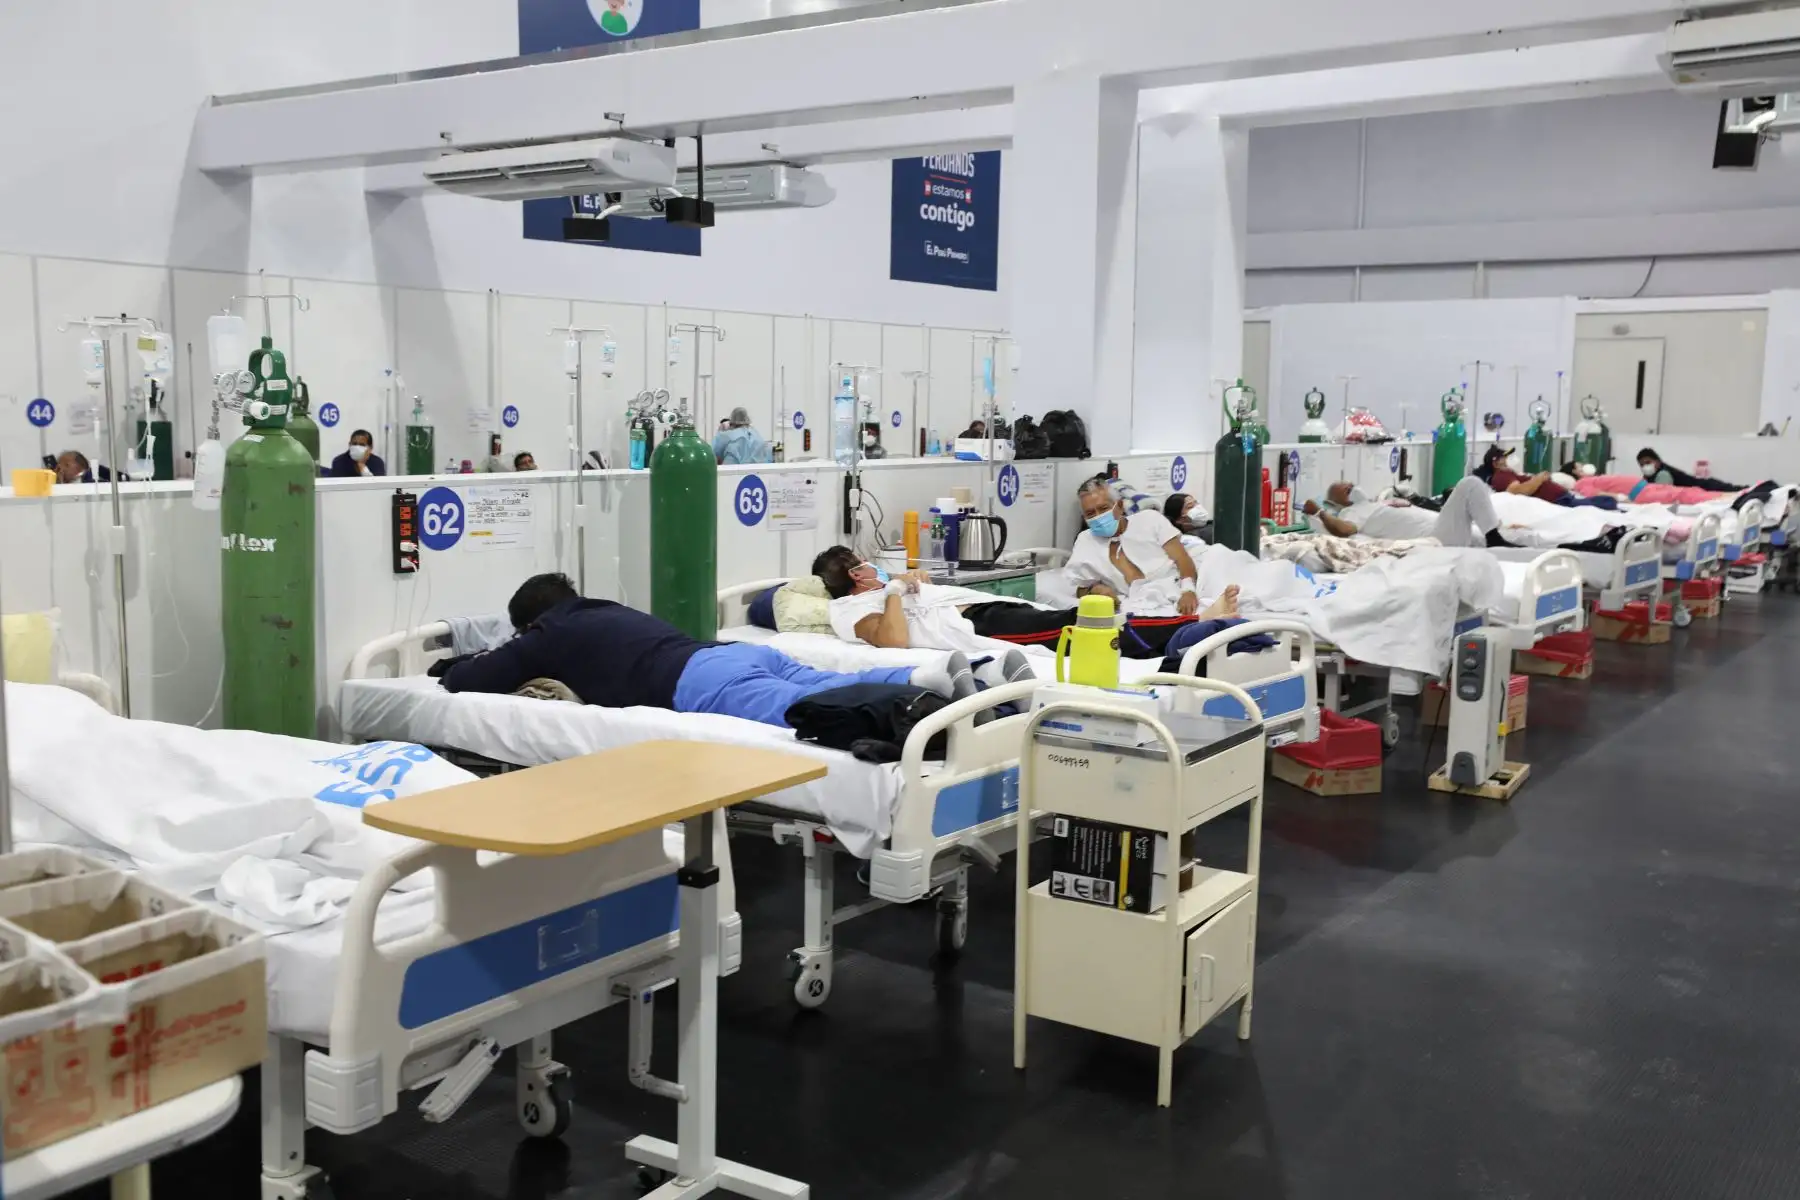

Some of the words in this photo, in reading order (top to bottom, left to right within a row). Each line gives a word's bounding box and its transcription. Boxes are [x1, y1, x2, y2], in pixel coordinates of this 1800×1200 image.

[932, 184, 964, 199] estamos
[920, 203, 975, 231] contigo
[30, 404, 53, 421] 44
[321, 408, 337, 422] 45
[504, 410, 518, 423] 46
[1173, 464, 1185, 484] 65
[1000, 474, 1017, 497] 64
[739, 487, 764, 514] 63
[423, 502, 460, 536] 62
